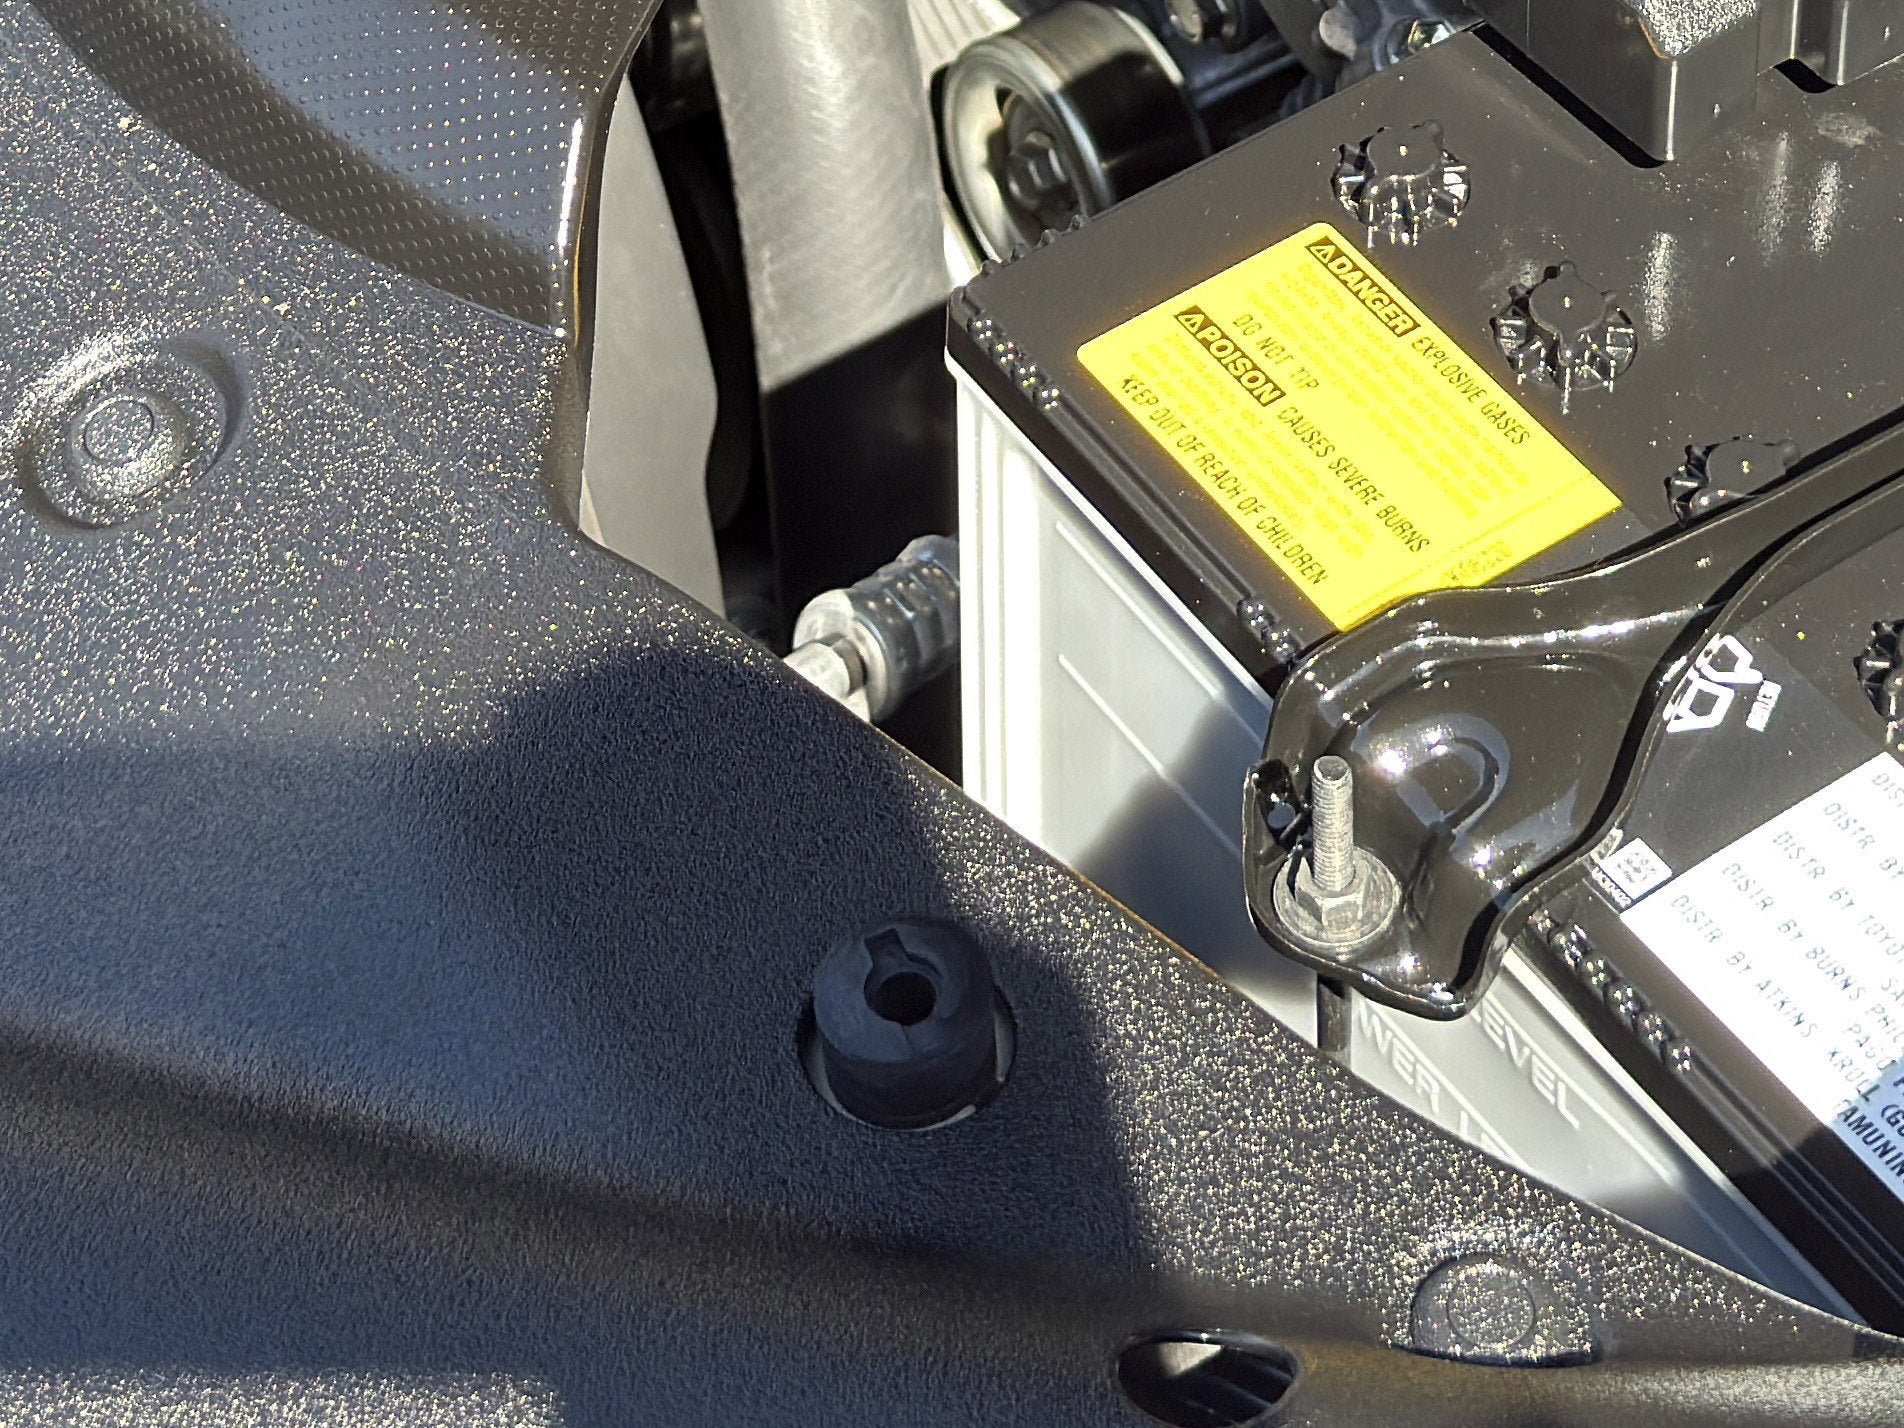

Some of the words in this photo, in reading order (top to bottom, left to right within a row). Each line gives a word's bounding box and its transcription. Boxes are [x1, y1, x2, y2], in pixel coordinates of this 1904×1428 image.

[1232, 312, 1263, 337] DO
[1256, 336, 1295, 366] NOT
[1289, 365, 1320, 390] TIP
[1326, 254, 1415, 336] DANGER
[1411, 335, 1487, 404] EXPLOSIVE
[1480, 401, 1532, 446] GASES
[1120, 373, 1160, 406] KEEP
[1149, 406, 1187, 436] OUT
[1176, 433, 1206, 453] OF
[1195, 451, 1247, 500] REACH
[1237, 495, 1267, 516] OF
[1256, 515, 1329, 585] CHILDREN
[1195, 325, 1283, 405] POISON
[1277, 406, 1336, 458] CAUSES
[1328, 455, 1386, 507] SEVERE
[1375, 504, 1431, 553] BURNS
[1828, 887, 1855, 910] BY
[1726, 951, 1752, 974] BY
[1755, 980, 1818, 1038] ATKINS
[1777, 918, 1804, 941] BY
[1805, 946, 1866, 1001] BURNS
[1358, 997, 1440, 1116] WER
[1471, 997, 1581, 1130] EVEL
[1846, 1023, 1897, 1071] PAGO
